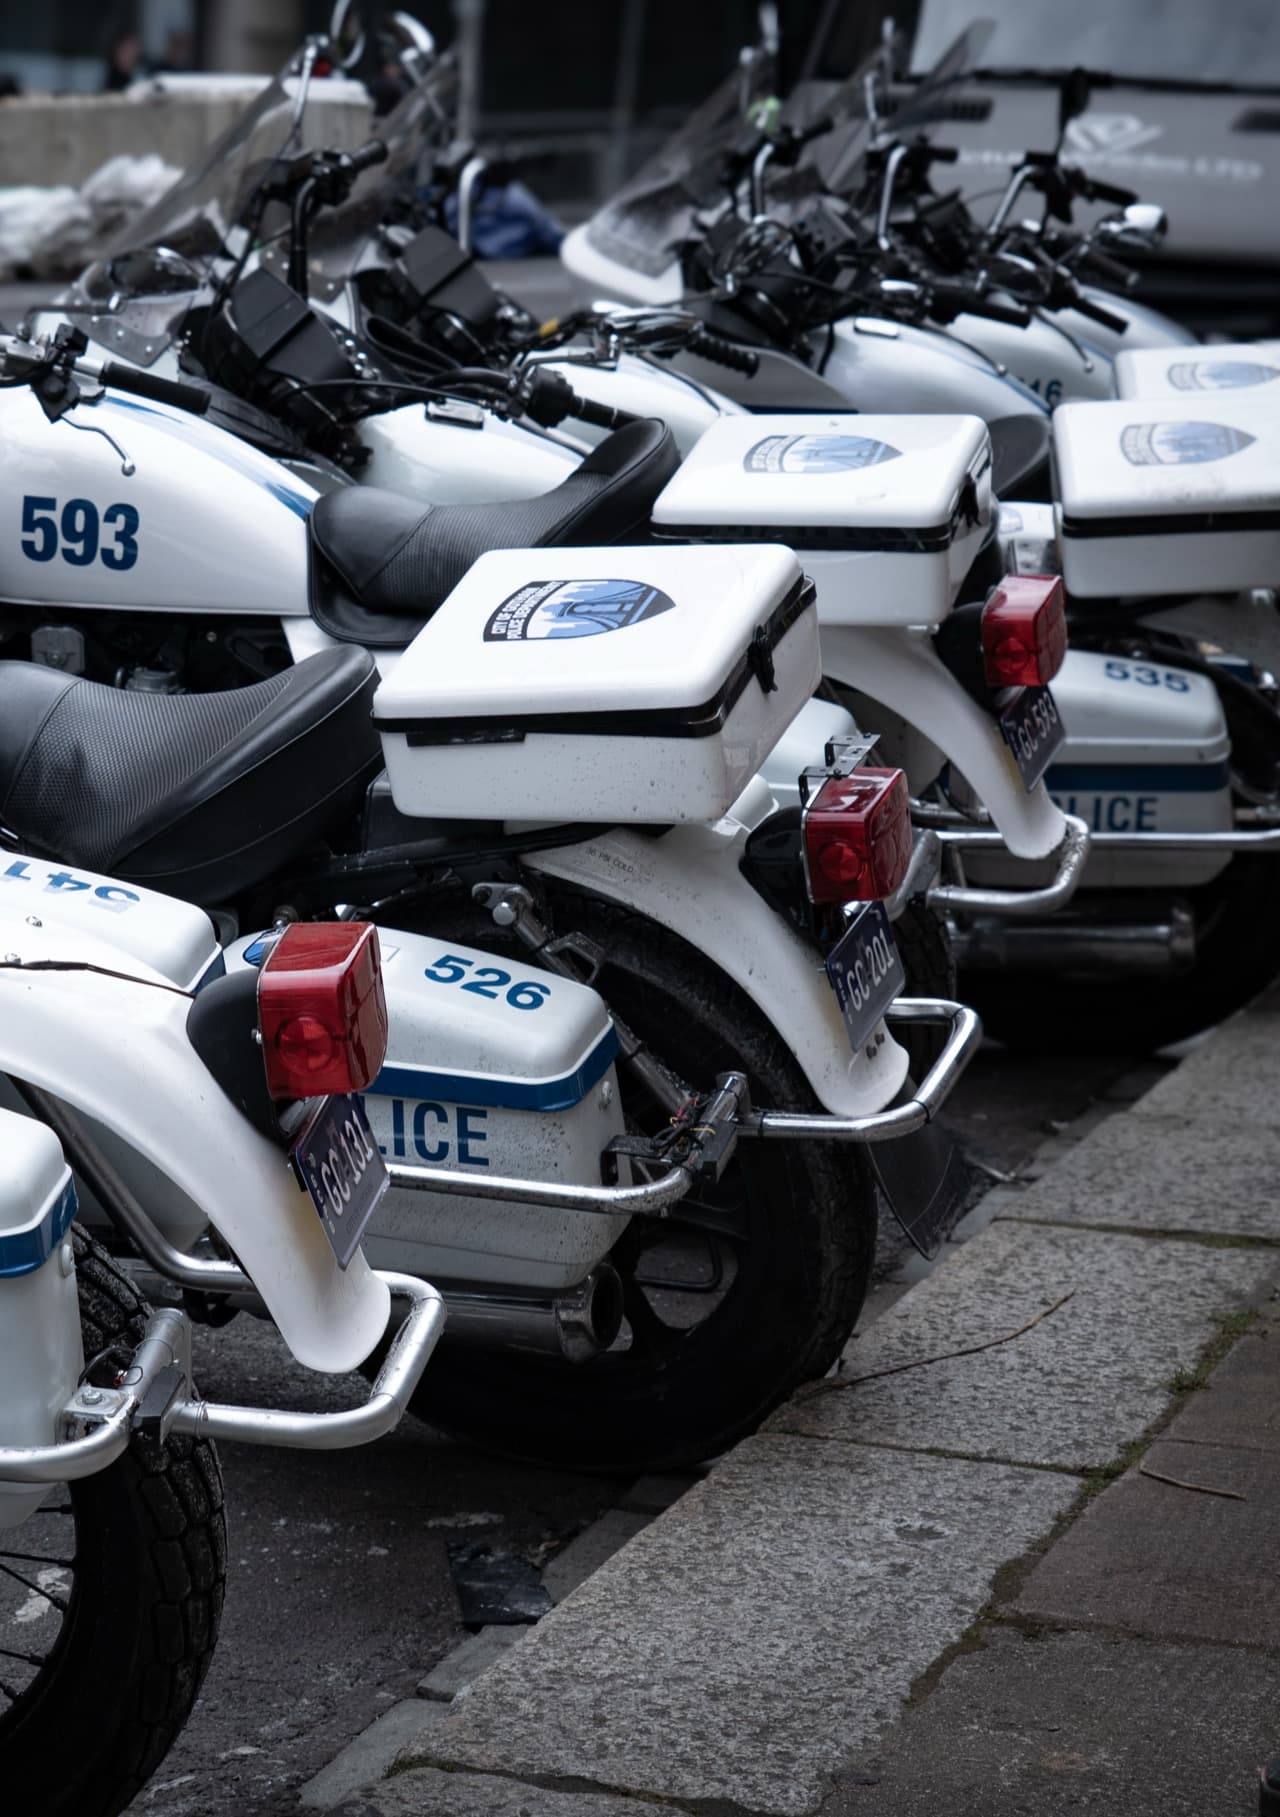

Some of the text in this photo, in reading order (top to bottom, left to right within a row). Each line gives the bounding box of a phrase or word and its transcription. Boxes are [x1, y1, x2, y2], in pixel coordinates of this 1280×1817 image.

[21, 495, 140, 571] 593
[1105, 661, 1190, 693] 535
[1018, 717, 1039, 761] GC
[1031, 691, 1058, 739] 593
[425, 954, 551, 1010] 526
[846, 928, 895, 1012] GC 201
[321, 1148, 352, 1217] GC
[339, 1110, 374, 1185] 131
